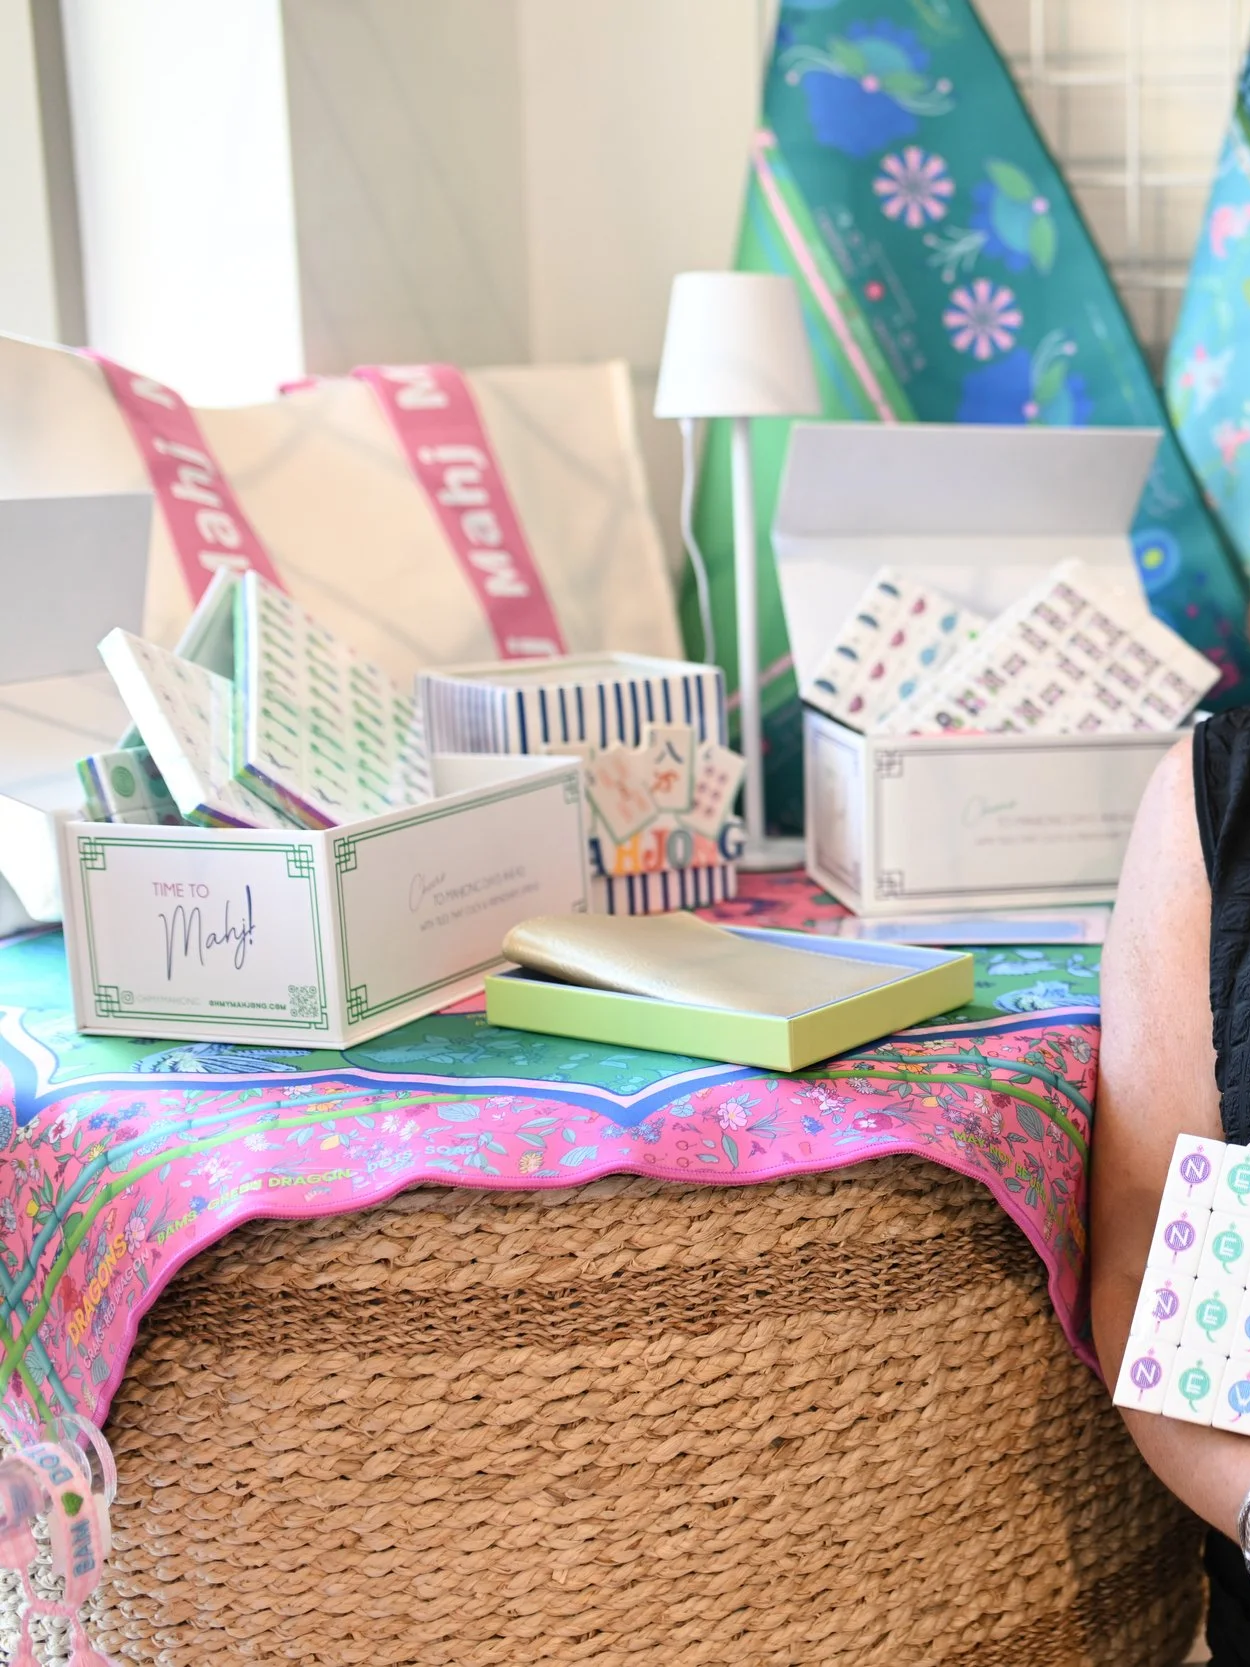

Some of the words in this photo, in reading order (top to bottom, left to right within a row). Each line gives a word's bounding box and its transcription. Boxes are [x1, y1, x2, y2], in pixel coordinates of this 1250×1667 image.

[153, 882, 184, 898] TIME
[188, 883, 210, 899] TO
[158, 885, 256, 981] Mahj!
[953, 1130, 985, 1147] MAY
[268, 1168, 352, 1188] DRAGON
[67, 1233, 127, 1346] DRAGONS
[113, 1248, 150, 1305] DRAGON
